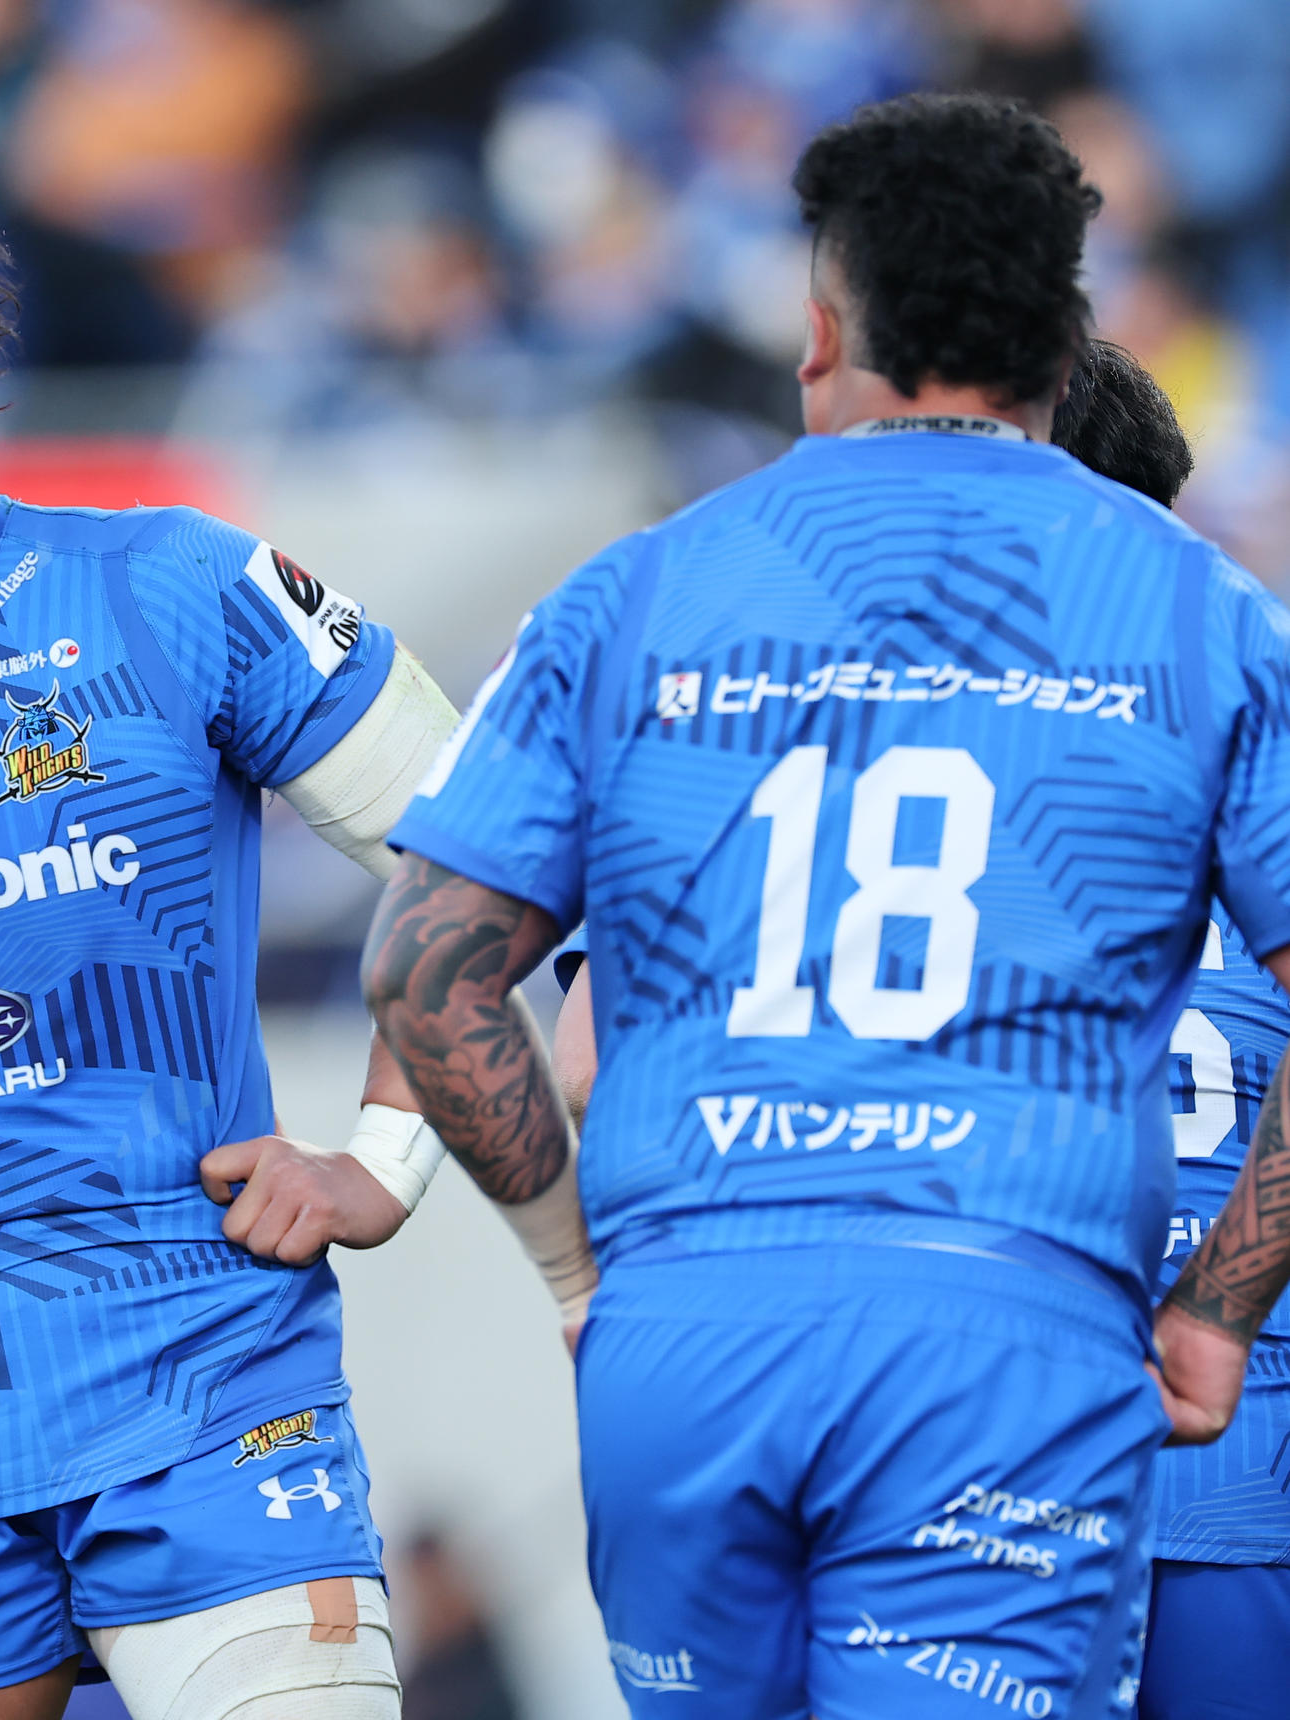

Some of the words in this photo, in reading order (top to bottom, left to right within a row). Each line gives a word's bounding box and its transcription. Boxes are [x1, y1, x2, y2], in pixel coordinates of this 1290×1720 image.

[710, 662, 1146, 723] ヒト・コミュニケーションズ
[6, 744, 51, 780] WILD
[21, 744, 83, 797] KNIGHTS
[726, 744, 996, 1041] 18
[257, 1411, 313, 1454] KNIGHTS
[913, 1518, 1058, 1579] Homes
[905, 1639, 1054, 1719] ziaino
